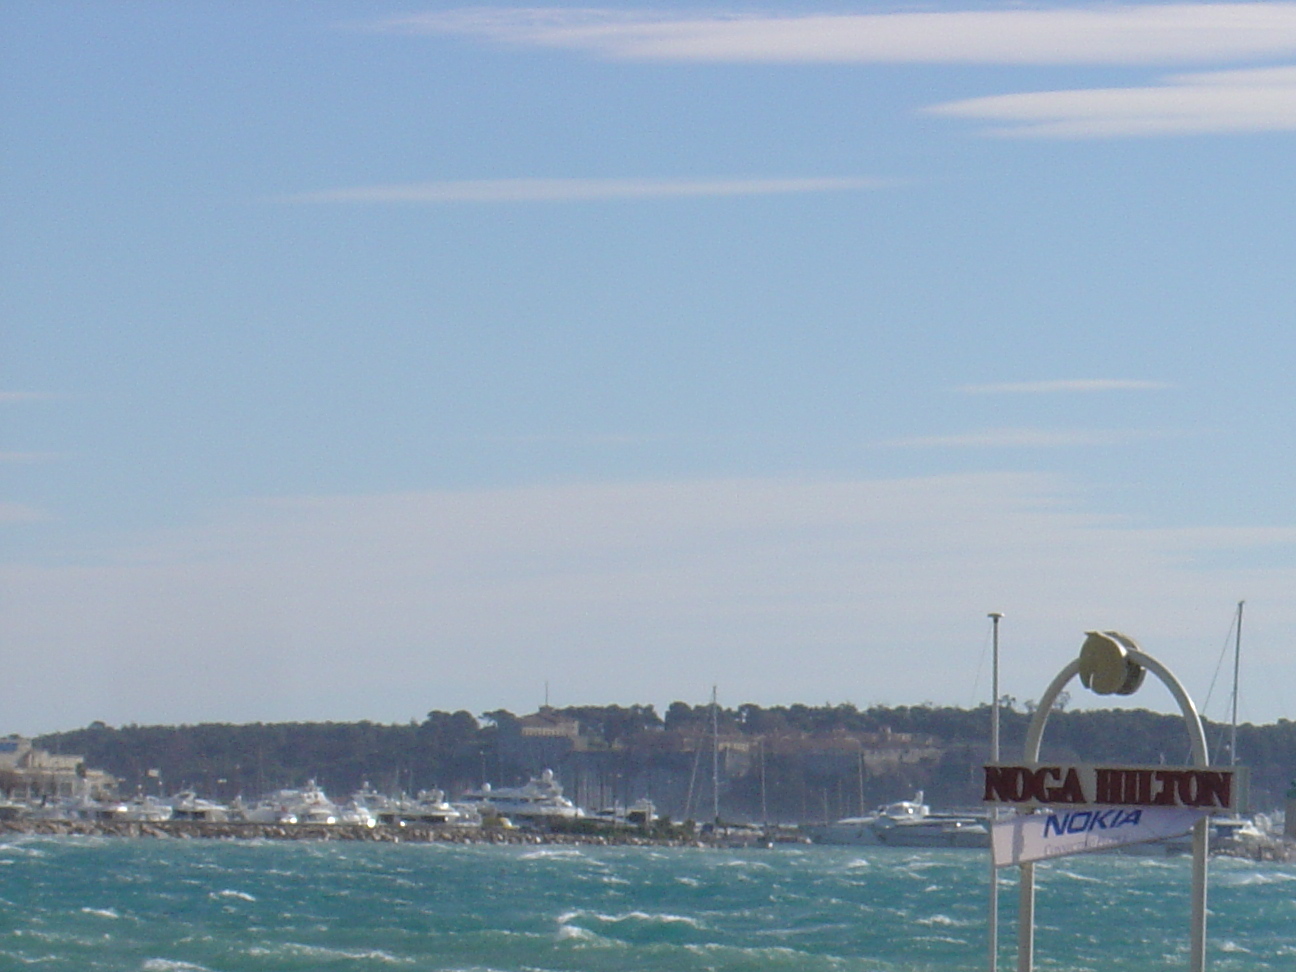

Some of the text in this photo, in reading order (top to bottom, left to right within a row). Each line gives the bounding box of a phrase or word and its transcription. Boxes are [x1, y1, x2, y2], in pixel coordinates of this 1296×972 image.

[983, 766, 1233, 808] NOGA HILTON
[1044, 809, 1143, 838] NOKIA
